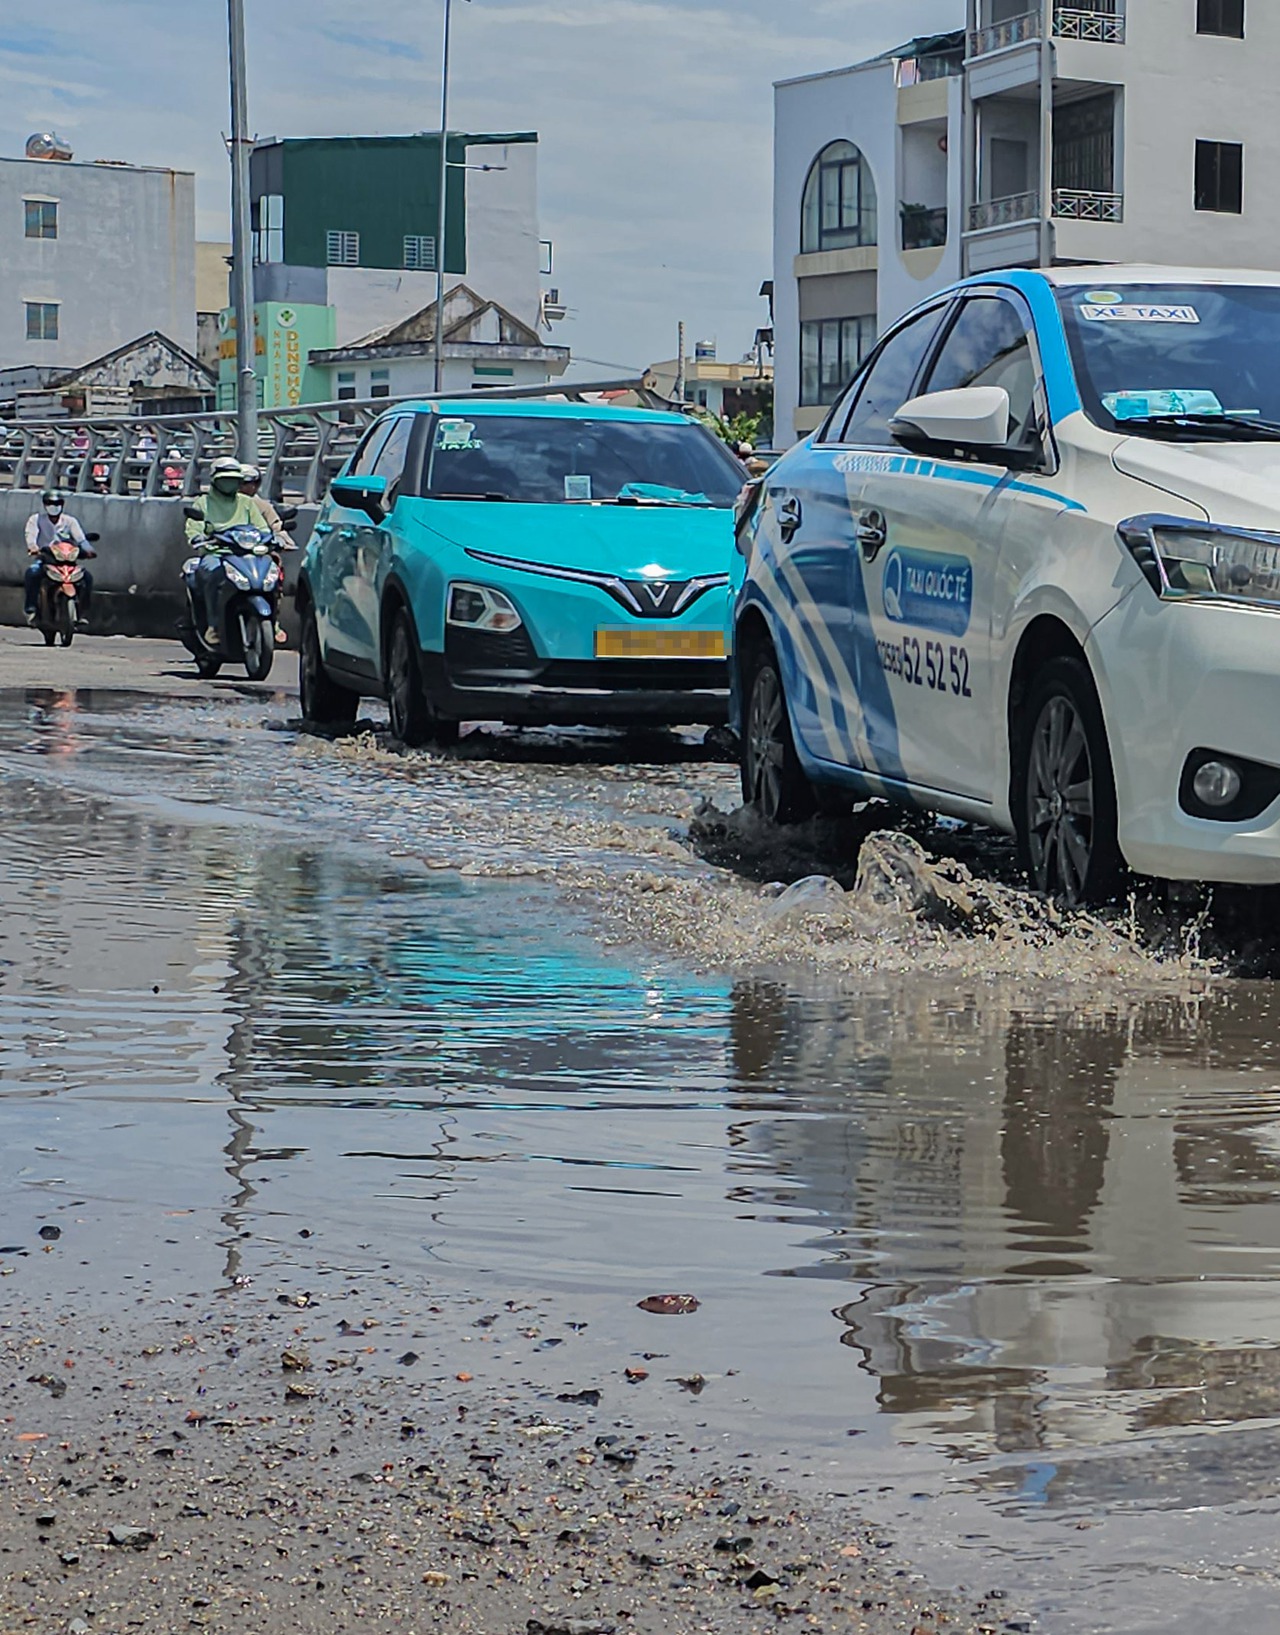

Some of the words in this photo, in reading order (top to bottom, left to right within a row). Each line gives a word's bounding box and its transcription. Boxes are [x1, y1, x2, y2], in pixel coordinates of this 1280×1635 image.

[1093, 307, 1125, 318] XE
[1131, 307, 1189, 319] TAXI
[906, 567, 924, 595] TAXI
[925, 563, 954, 601] QUỐC
[956, 567, 970, 602] TẾ
[903, 636, 923, 686] 52
[926, 640, 947, 692] 52
[949, 645, 972, 698] 52
